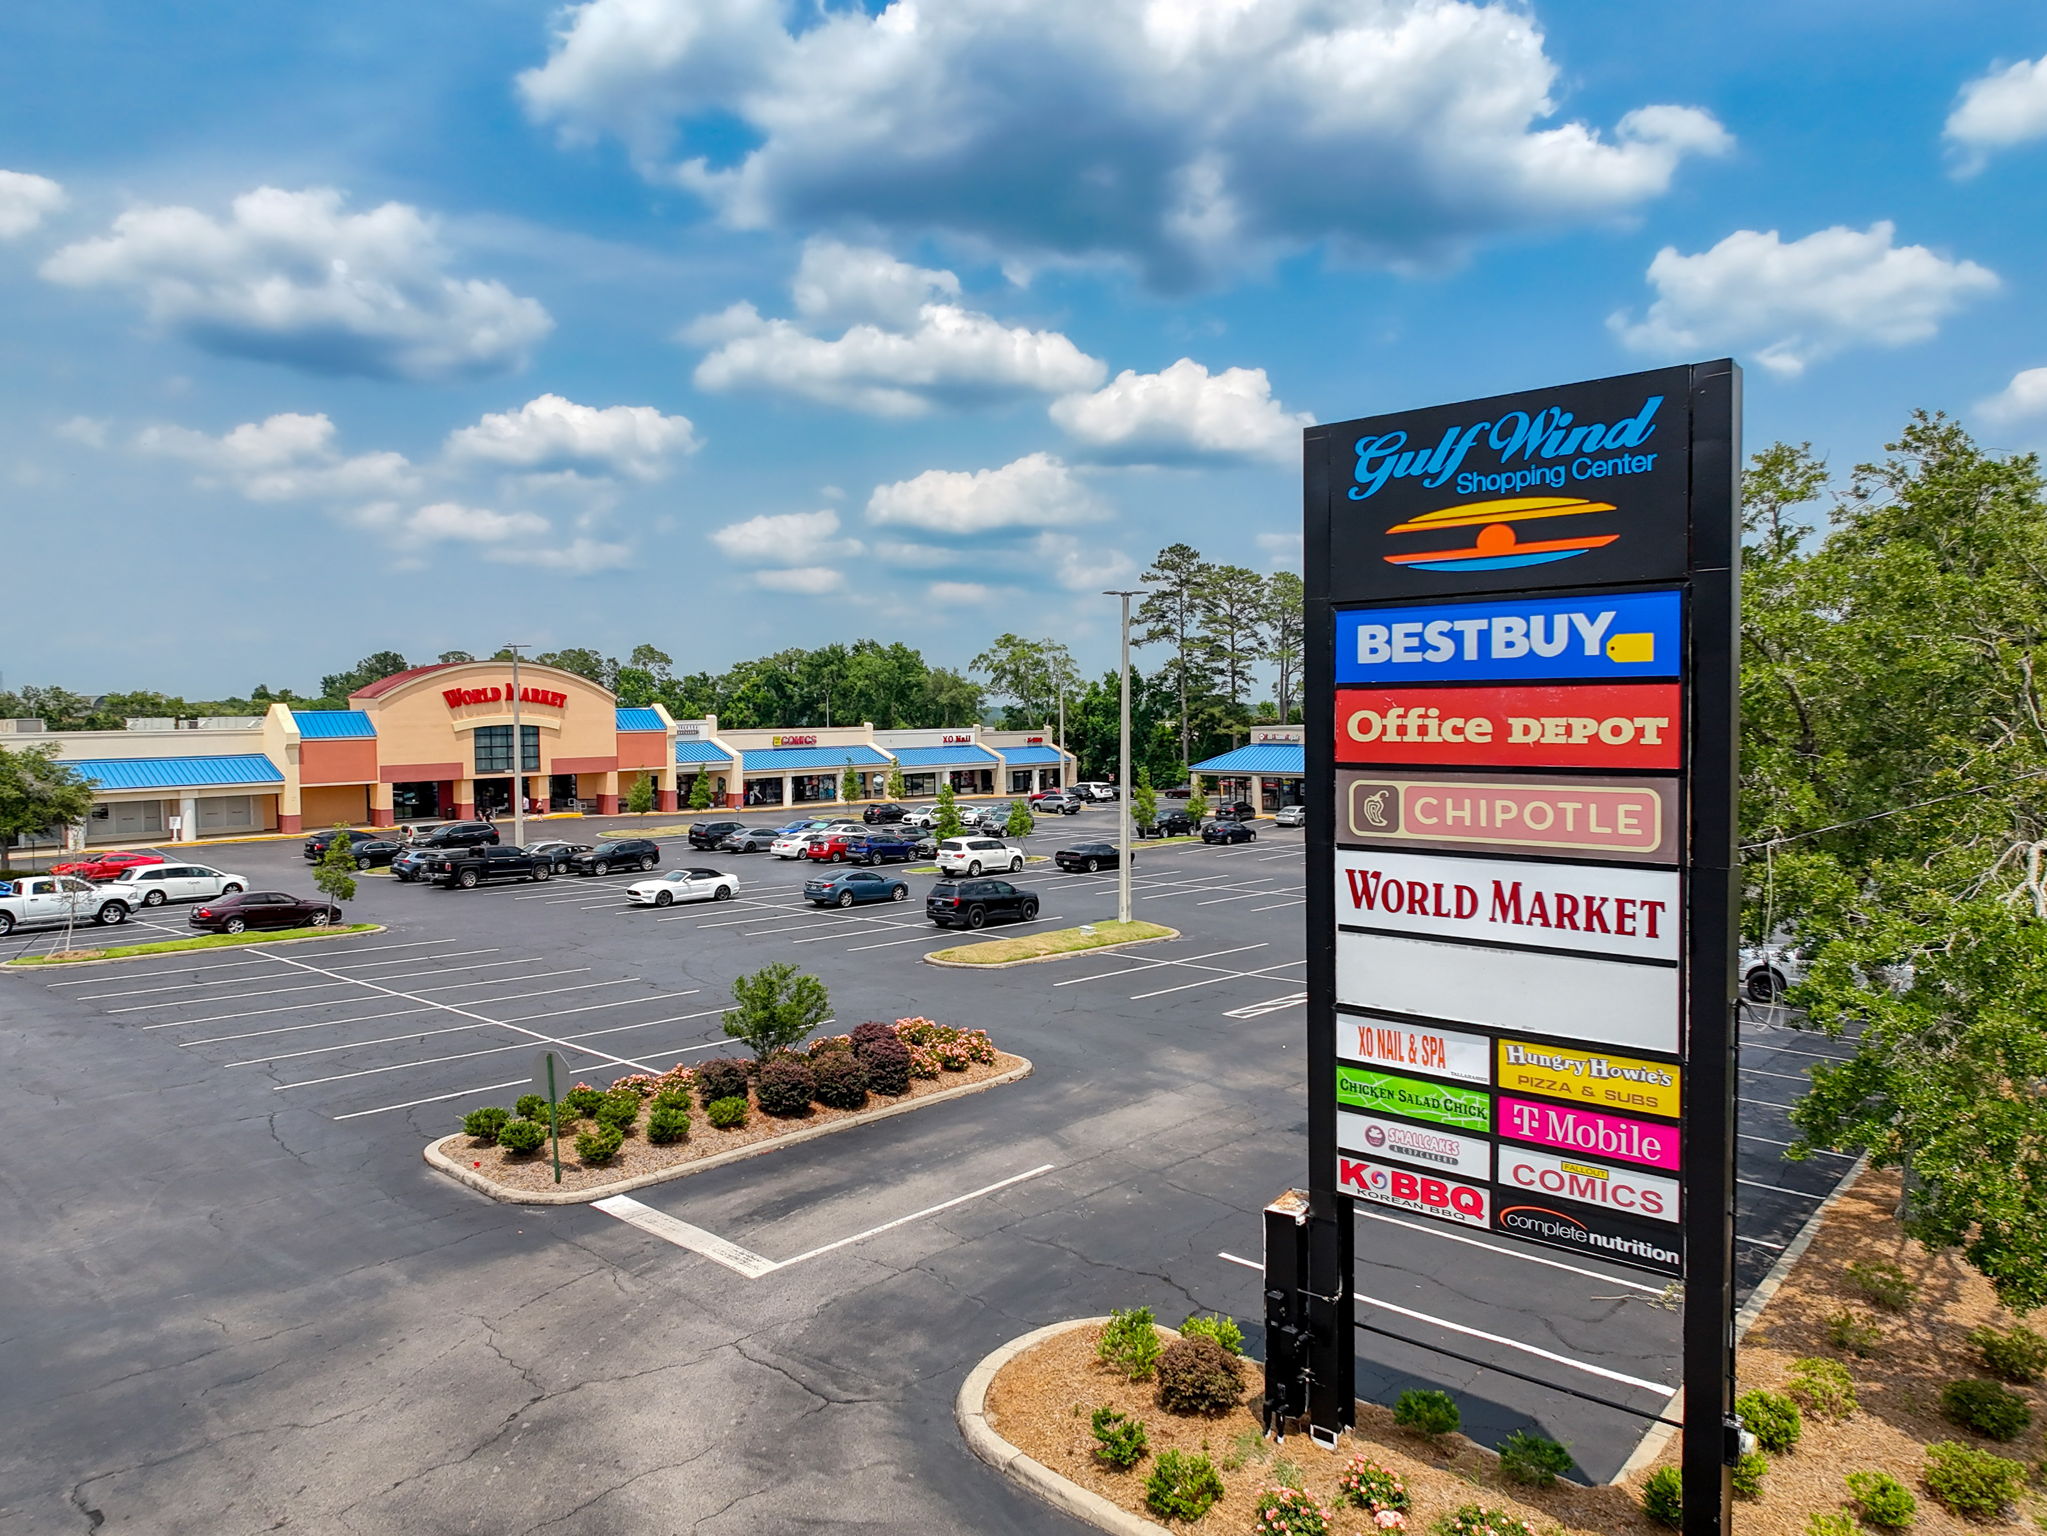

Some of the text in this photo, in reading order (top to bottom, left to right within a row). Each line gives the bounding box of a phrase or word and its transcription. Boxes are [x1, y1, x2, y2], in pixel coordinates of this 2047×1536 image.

[1348, 396, 1664, 500] Gulf Wind
[1456, 453, 1659, 495] Shopping Center
[442, 687, 502, 709] WORLD
[781, 735, 817, 746] COMICS
[1347, 707, 1669, 746] Office DEPOT
[1414, 797, 1643, 836] CHIPOTLE
[1345, 868, 1666, 939] WORLD MARKET
[1358, 1026, 1446, 1069] XO NAIL & SPA
[1506, 1045, 1673, 1087] Hungry Howie's
[1340, 1078, 1488, 1120] CHICKEN SALAD CHICK
[1518, 1074, 1659, 1108] PIZZA & SUBS
[1388, 1128, 1460, 1156] SMALLCAKES
[1512, 1164, 1664, 1214] COMICS
[1563, 1163, 1606, 1178] FALLOUT
[1357, 1188, 1467, 1222] KOREAN BBQ
[1507, 1213, 1680, 1265] complete nutrition
